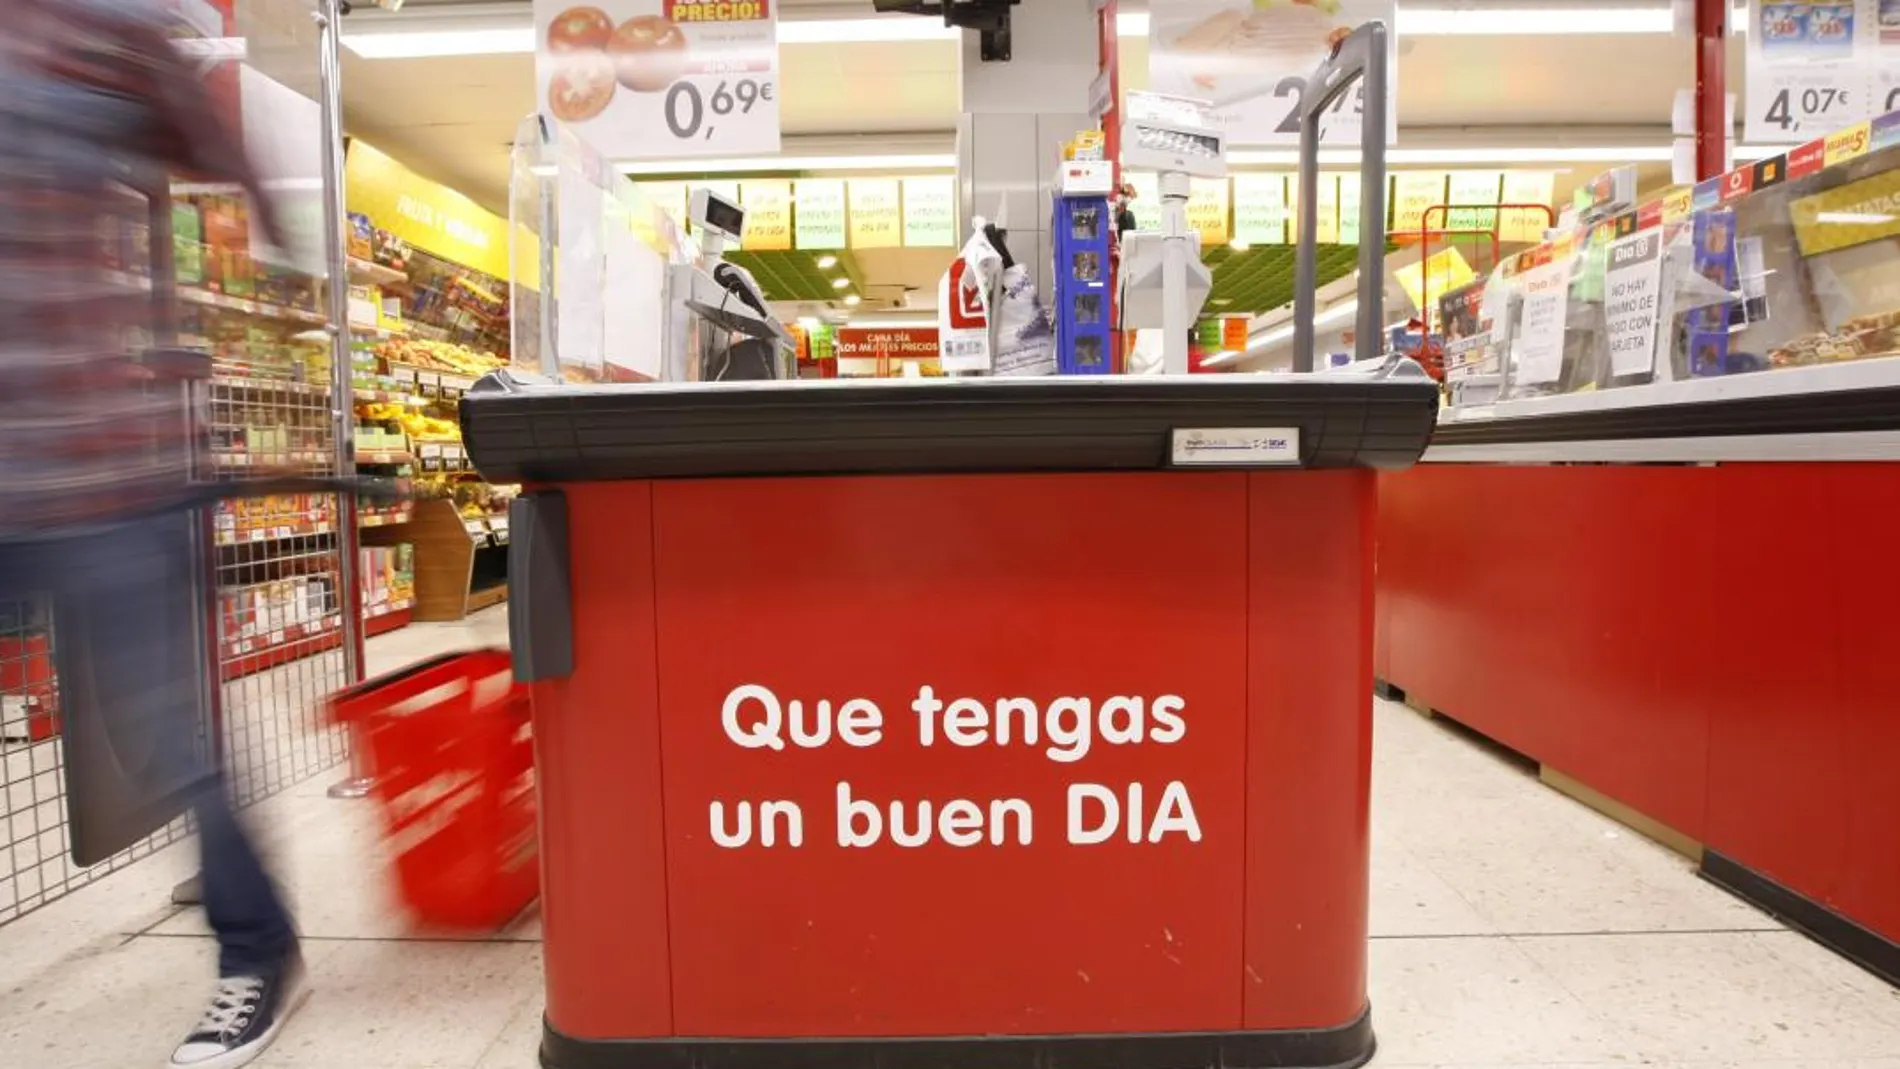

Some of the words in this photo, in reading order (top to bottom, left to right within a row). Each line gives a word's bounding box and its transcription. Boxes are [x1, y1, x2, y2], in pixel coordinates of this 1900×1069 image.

[672, 2, 761, 21] PRECIO!
[664, 79, 773, 142] 0,69€
[1764, 88, 1849, 133] 4,07€
[1611, 283, 1625, 298] NO
[1627, 277, 1648, 295] HAY
[1639, 294, 1654, 310] DE
[1629, 315, 1652, 332] CON
[1612, 335, 1645, 352] ARJETA
[721, 684, 883, 751] Que
[911, 685, 1187, 763] tengas
[709, 800, 803, 848] un
[836, 781, 1033, 848] buen
[1067, 781, 1203, 845] DIA
